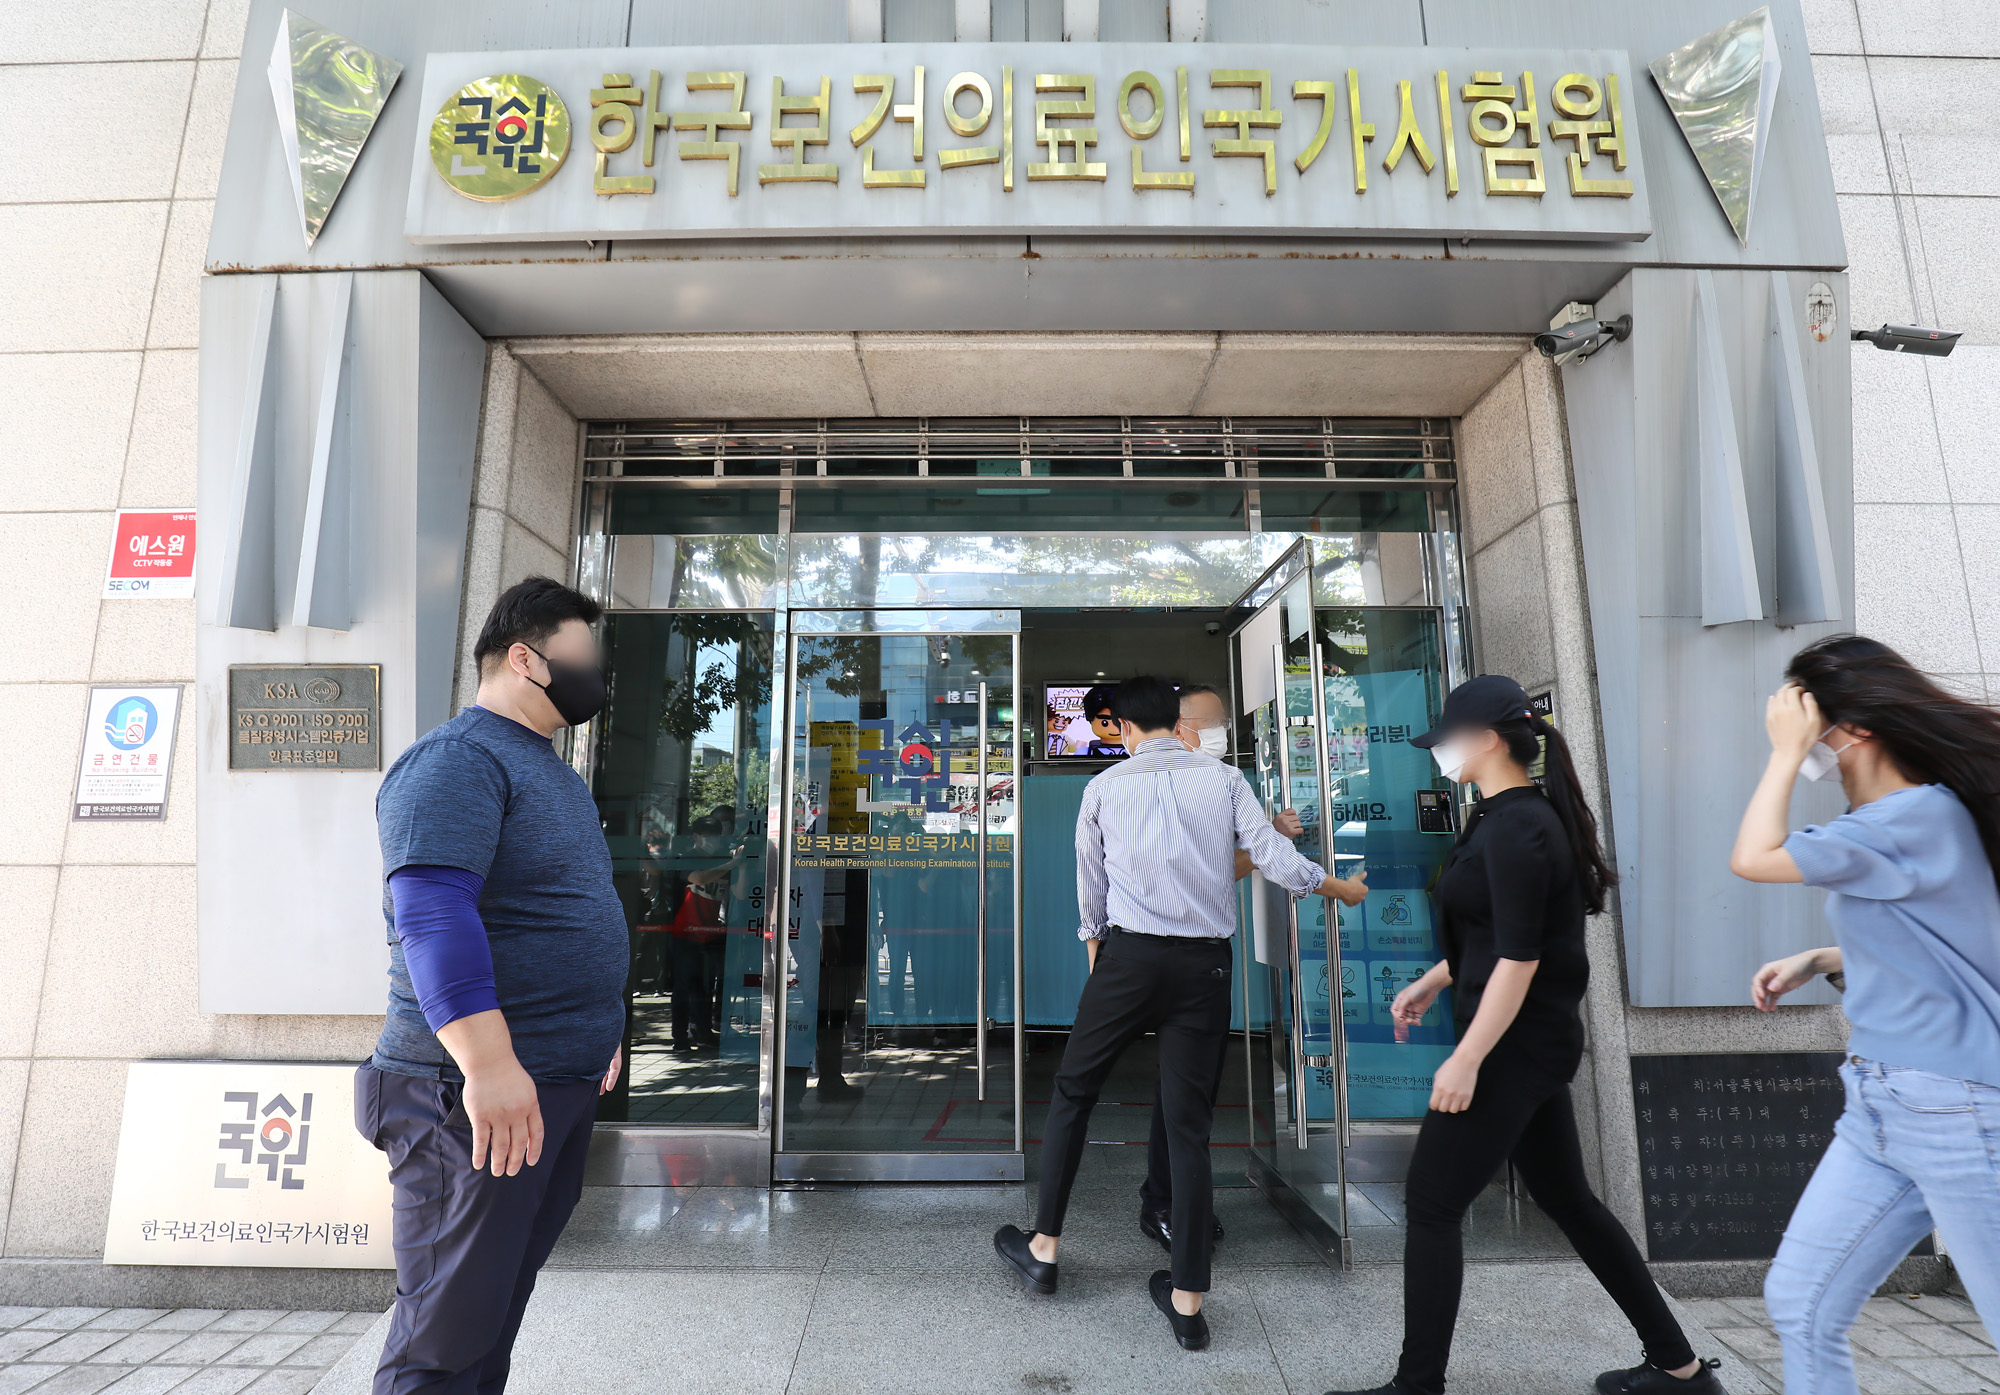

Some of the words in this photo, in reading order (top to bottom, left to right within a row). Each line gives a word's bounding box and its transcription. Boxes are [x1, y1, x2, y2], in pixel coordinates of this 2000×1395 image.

[590, 64, 1635, 198] 한국보건의료인국가시험원
[129, 534, 185, 556] 에스원
[133, 559, 153, 567] CCTV
[108, 580, 150, 591] SECOM
[264, 683, 300, 699] KSA
[238, 714, 254, 727] KS
[257, 714, 269, 727] Q
[273, 714, 304, 727] 9001
[312, 714, 334, 727] ISO
[338, 714, 369, 727] 9001
[239, 730, 369, 744] 품질경영시스템인증기업
[269, 750, 339, 764] 한국표준협회
[794, 858, 818, 868] Korea
[819, 858, 845, 868] Health
[847, 858, 886, 868] Personnel
[888, 858, 926, 869] Licensing
[928, 858, 977, 869] Examination
[748, 886, 803, 909] 응자
[748, 917, 801, 940] 대실
[141, 1220, 370, 1246] 한국보건의료인국가시험원
